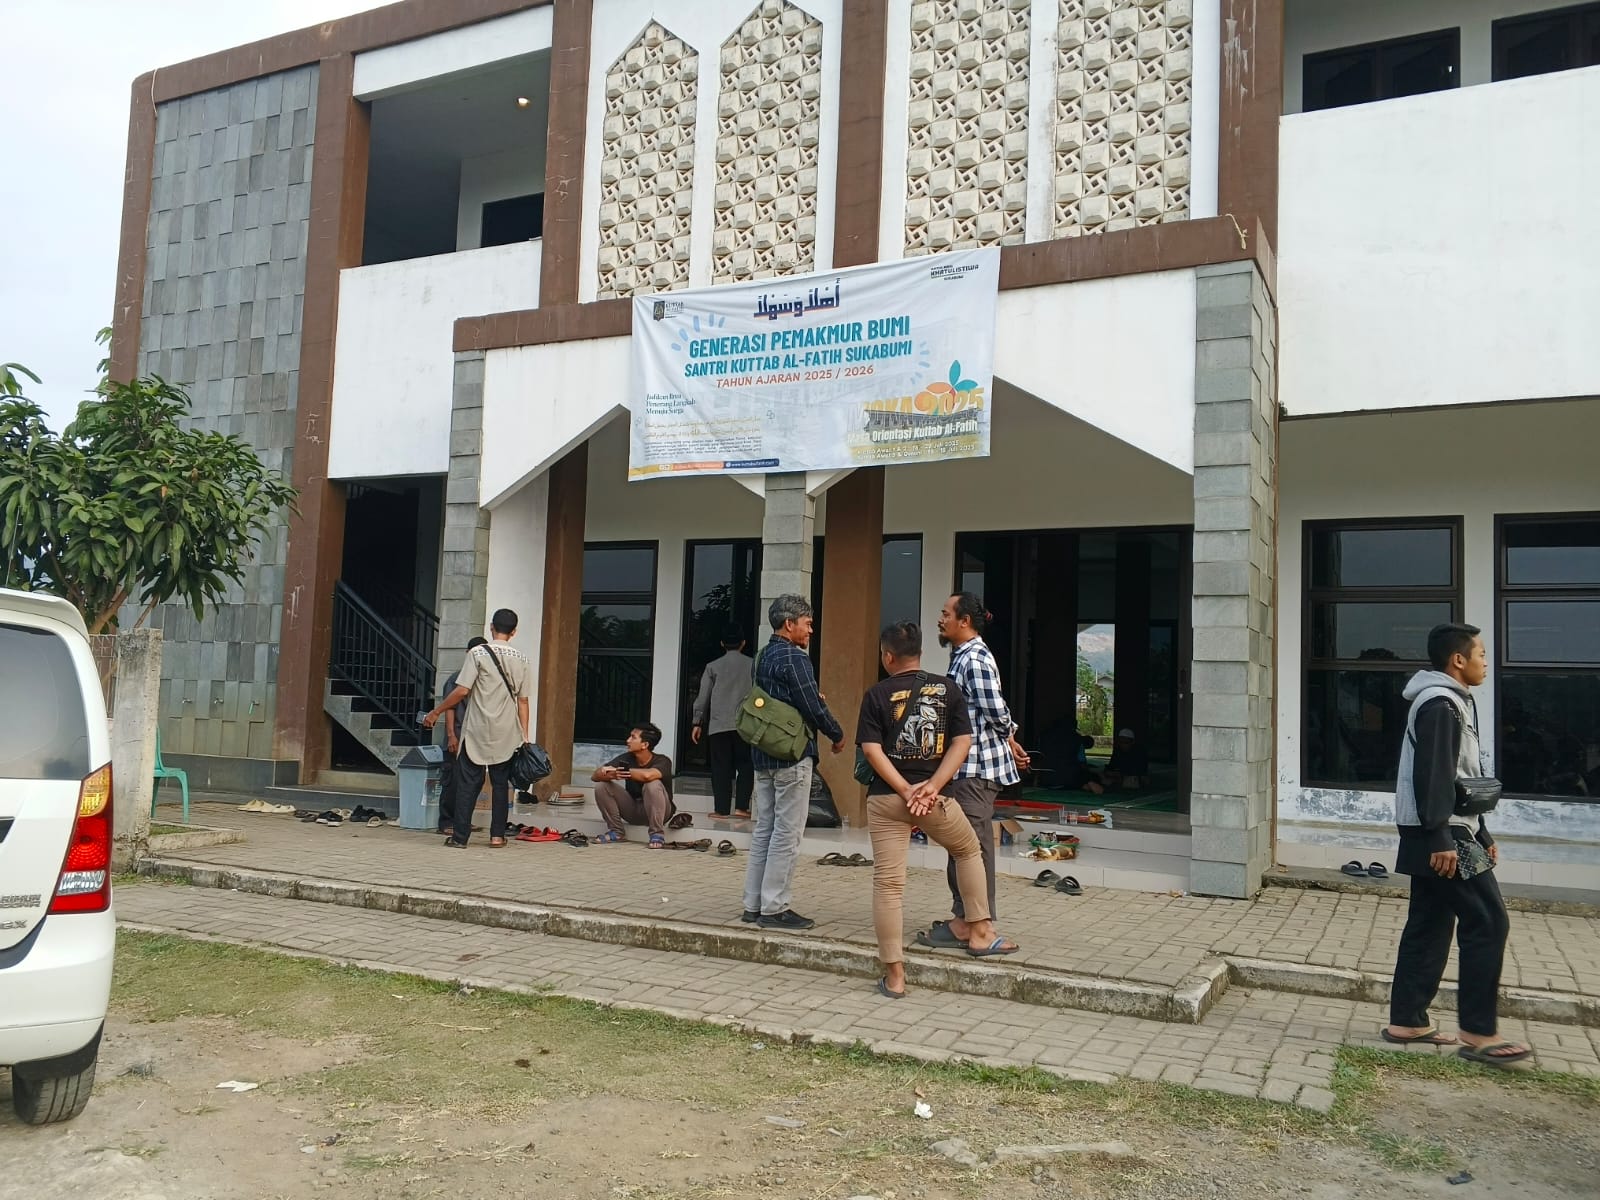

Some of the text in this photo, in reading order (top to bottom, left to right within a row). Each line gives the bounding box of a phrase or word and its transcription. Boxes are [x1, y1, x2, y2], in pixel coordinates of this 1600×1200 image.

[690, 315, 910, 359] GENERASI PEMAKMUR BUMI
[684, 340, 912, 377] SANTRI KUTTAB AL-FATIH SUKABUMI
[716, 365, 874, 388] TAHUN AJARAN 2025 / 2026
[872, 426, 912, 442] Orientasi
[913, 424, 942, 438] Kuttab
[943, 419, 978, 434] Al-Fatih
